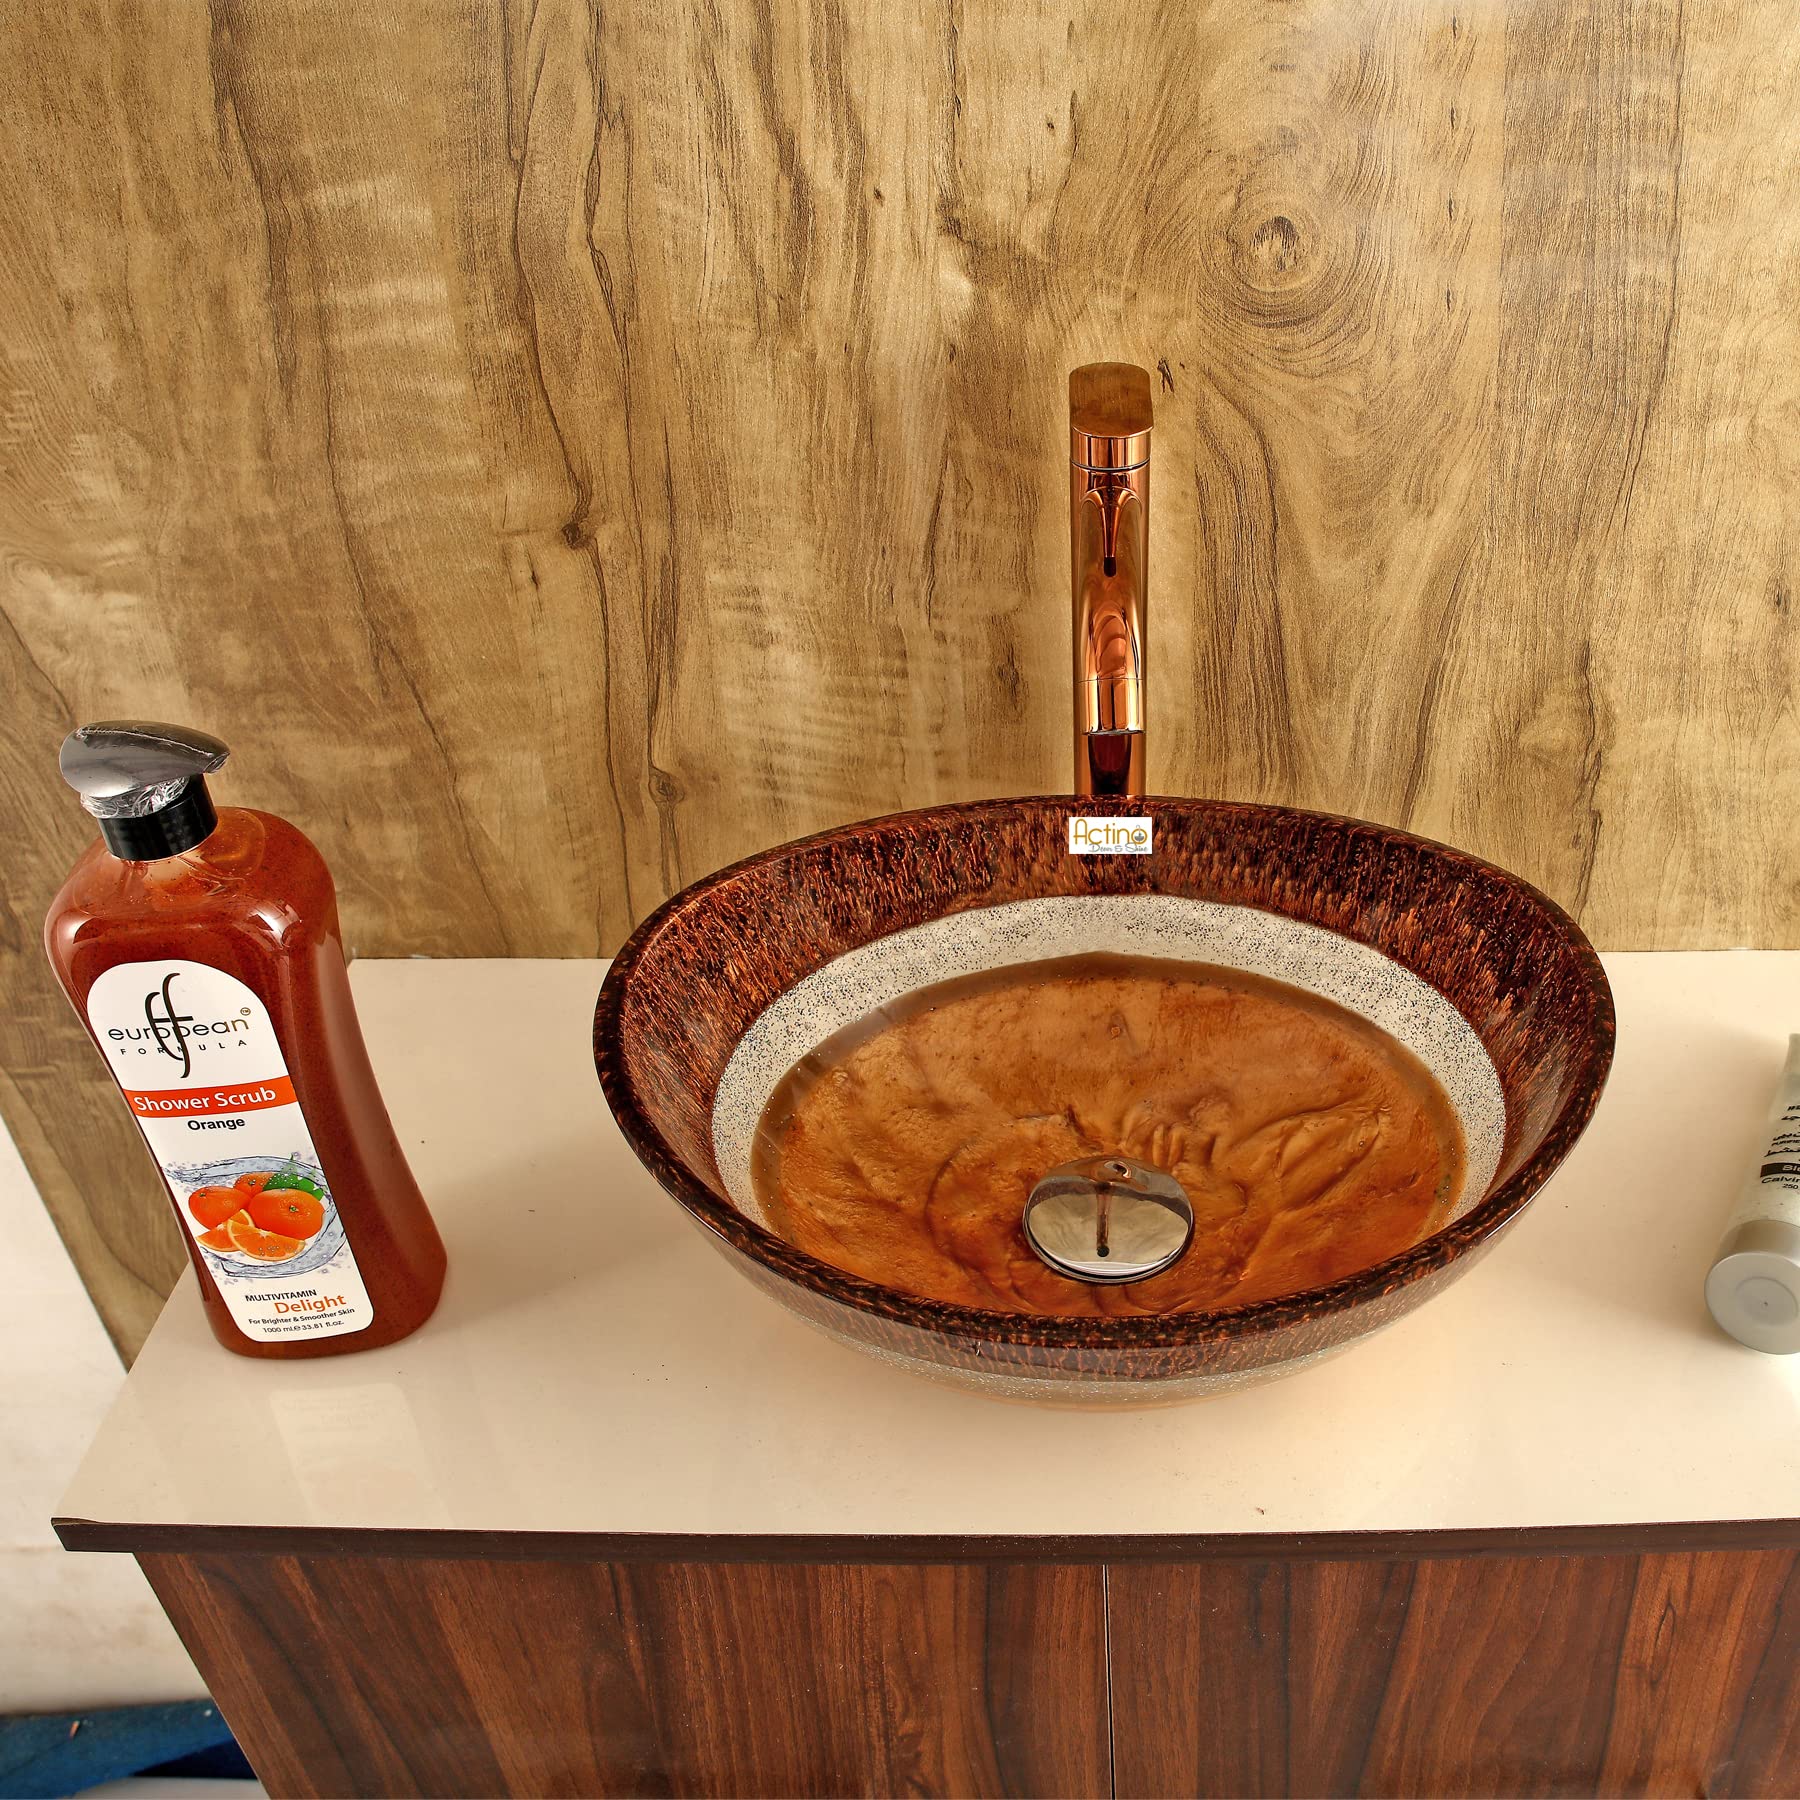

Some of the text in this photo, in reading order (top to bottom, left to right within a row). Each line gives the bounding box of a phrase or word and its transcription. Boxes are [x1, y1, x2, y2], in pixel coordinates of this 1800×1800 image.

[108, 1018, 249, 1043] european
[134, 1087, 276, 1111] Shower Scrub
[187, 1118, 245, 1130] Orange
[245, 1289, 317, 1302] MULTIVITAMIN
[274, 1294, 347, 1314] Delight
[262, 1316, 291, 1325] Brighter
[300, 1311, 337, 1322] Smoother
[338, 1308, 355, 1316] Skin
